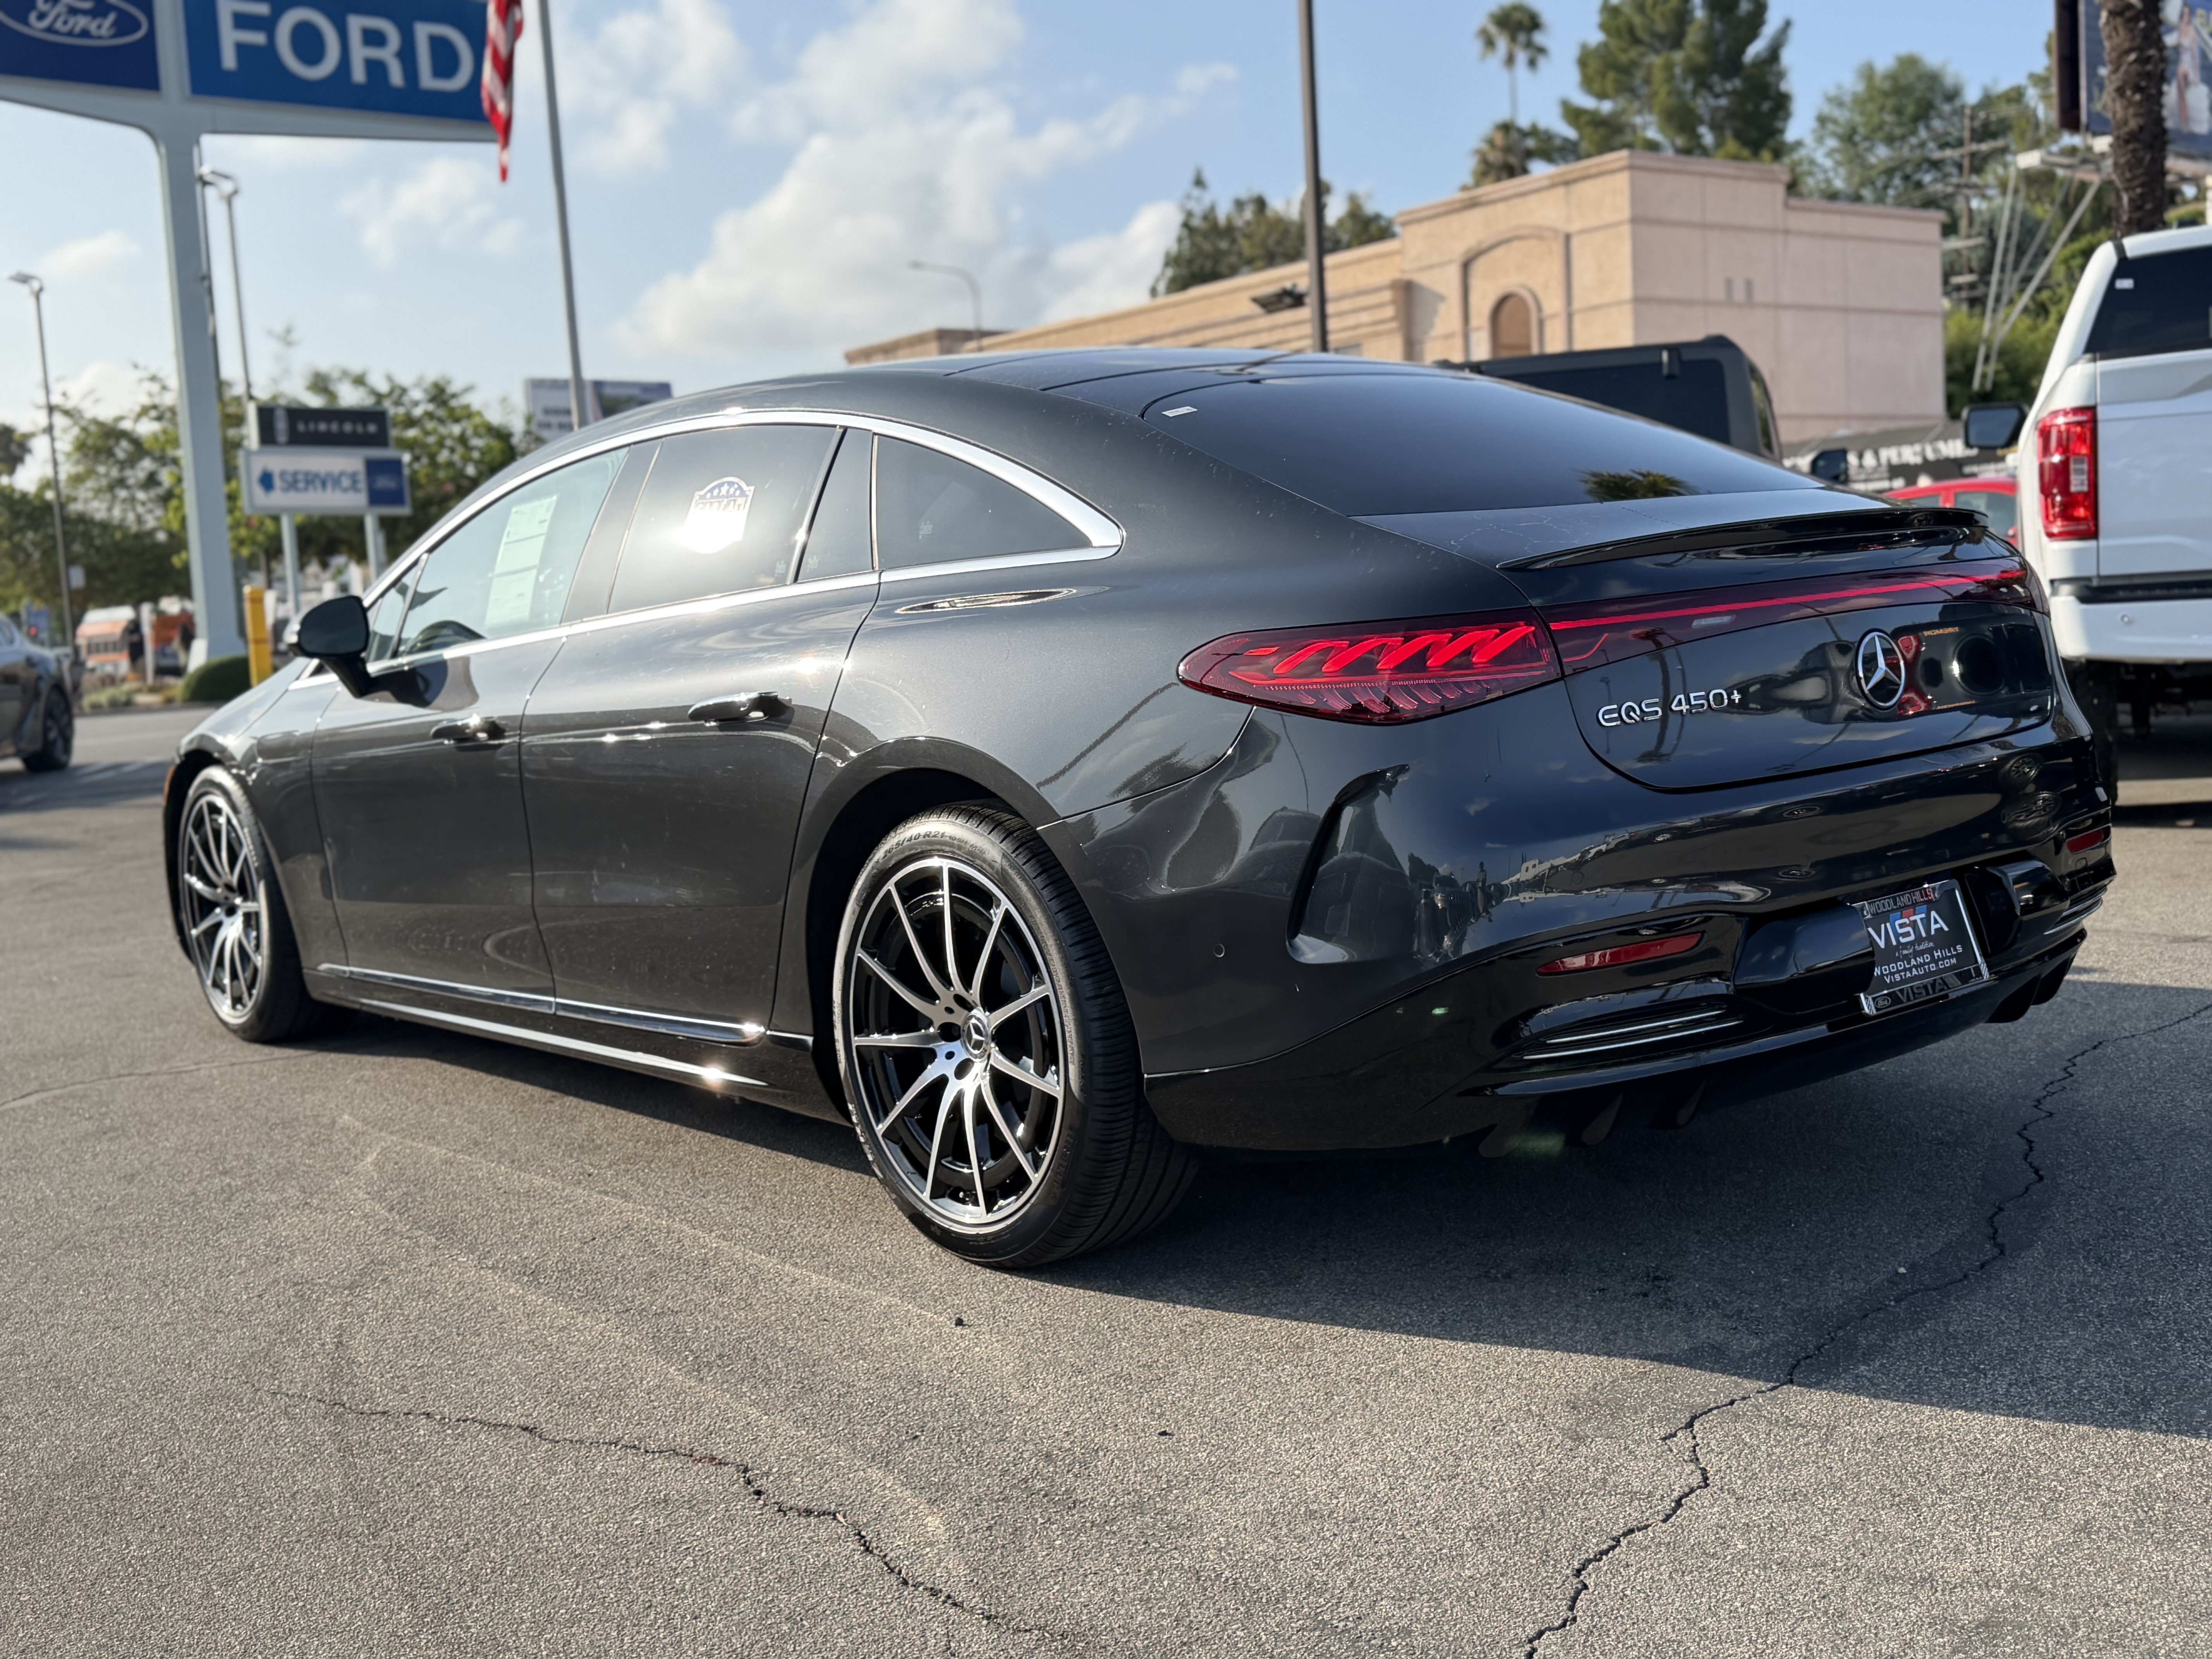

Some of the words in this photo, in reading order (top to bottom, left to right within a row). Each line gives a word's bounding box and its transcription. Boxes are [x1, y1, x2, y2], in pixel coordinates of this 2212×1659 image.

[28, 0, 118, 38] Ford
[216, 0, 474, 92] FORD
[296, 420, 379, 434] LINCOLN
[279, 469, 362, 494] SERVICE
[1597, 698, 1662, 726] EQS
[1671, 689, 1742, 716] 450+
[1869, 894, 1912, 915] WOODLAND
[1911, 888, 1932, 903] HILLS
[1867, 910, 1949, 949] VISTA
[1933, 945, 1963, 960] HILLS
[1896, 977, 1948, 1003] VISTA
